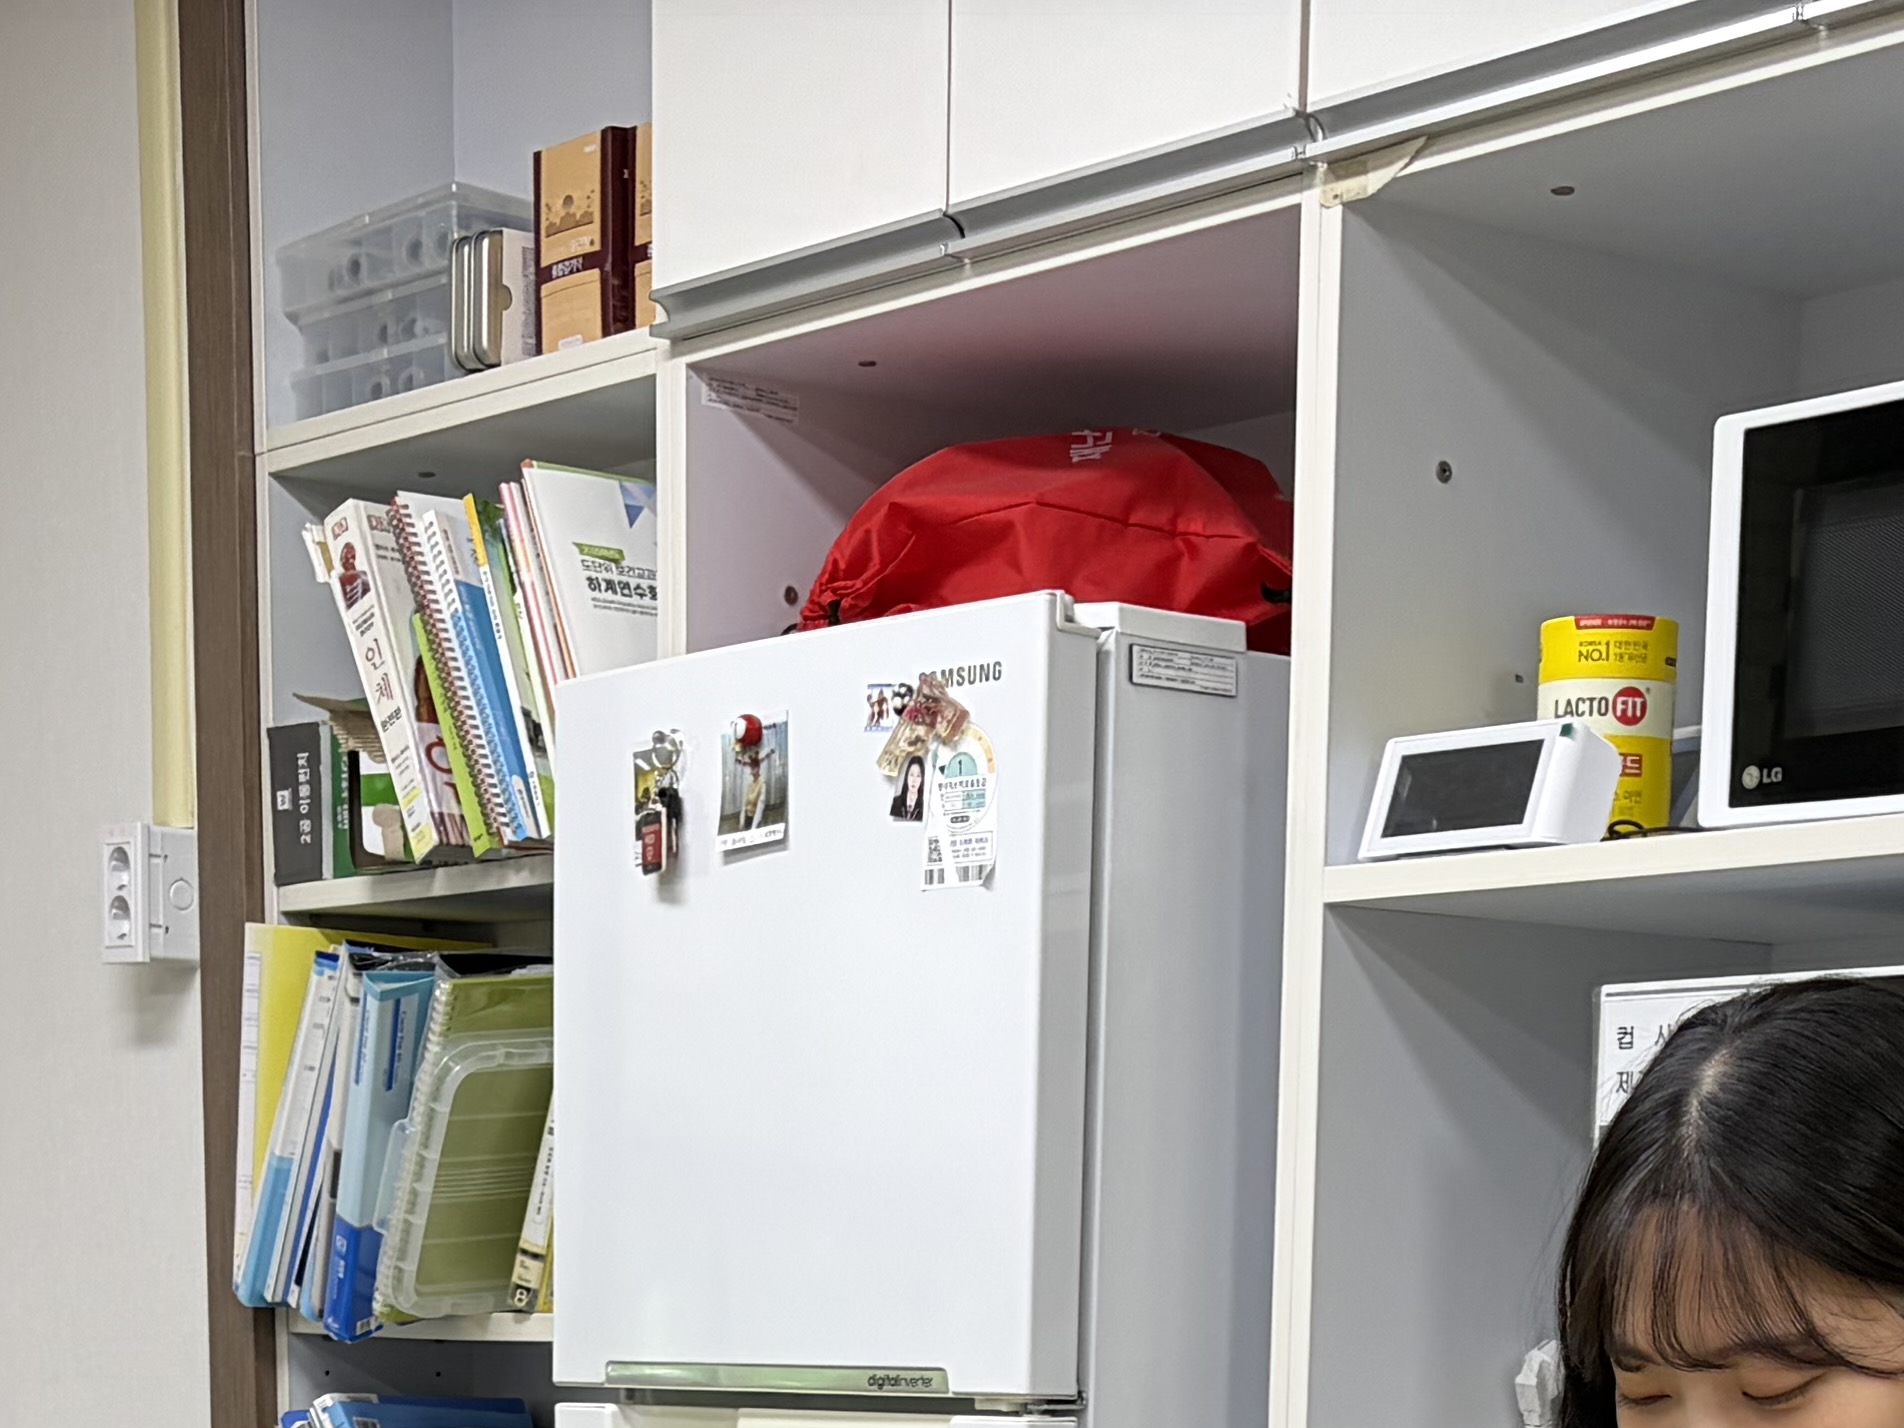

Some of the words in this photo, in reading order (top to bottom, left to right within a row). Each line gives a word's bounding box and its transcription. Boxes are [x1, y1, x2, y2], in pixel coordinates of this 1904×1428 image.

[1578, 640, 1610, 663] NO.1
[930, 661, 1002, 689] MSUNG
[1554, 696, 1609, 719] LACTO
[1615, 697, 1646, 718] FIT
[1762, 767, 1783, 783] LG
[1616, 1025, 1635, 1050] 컵
